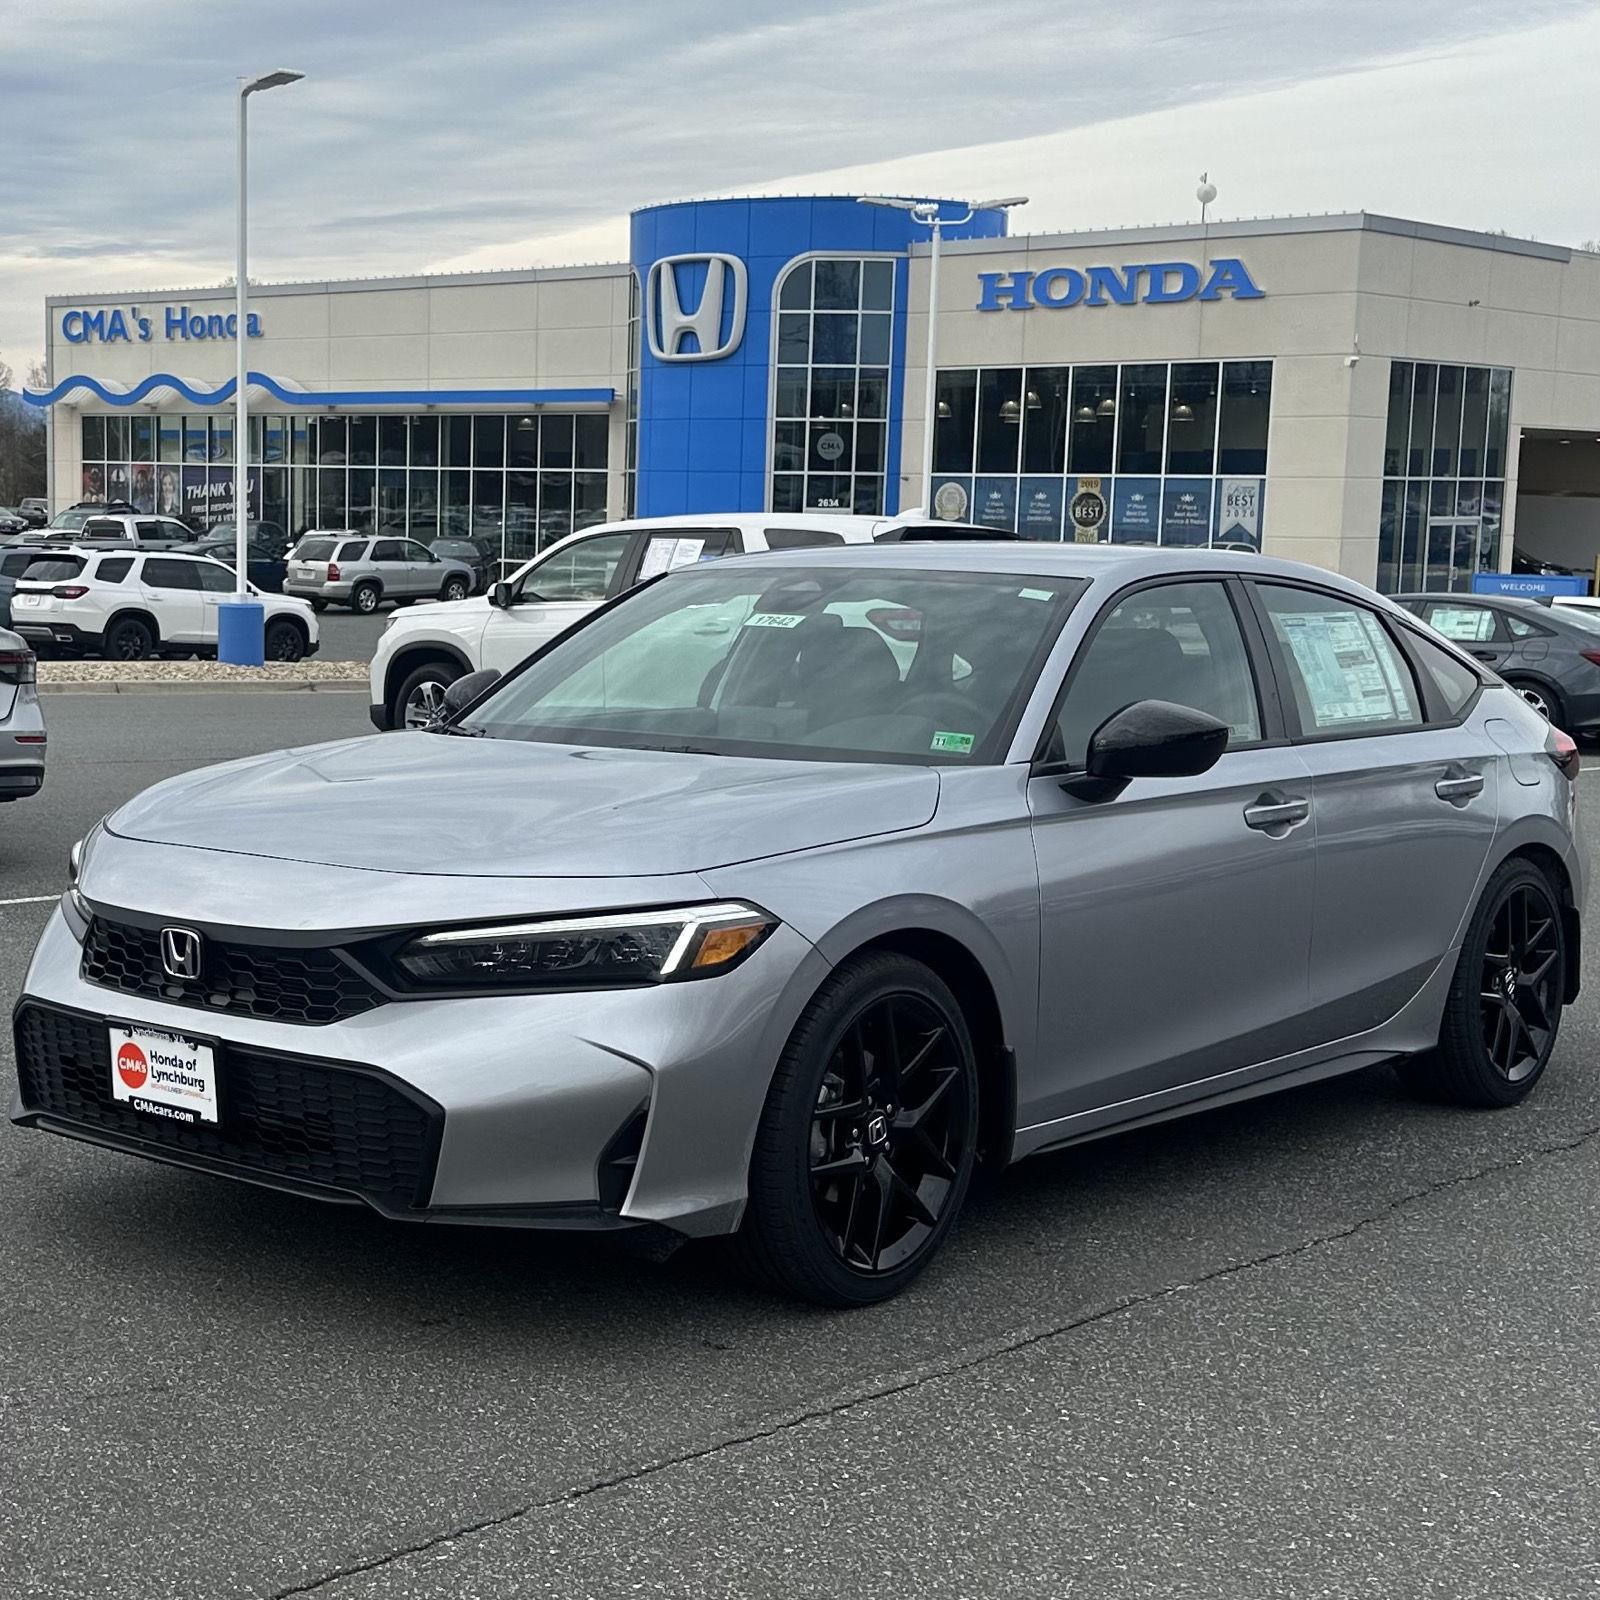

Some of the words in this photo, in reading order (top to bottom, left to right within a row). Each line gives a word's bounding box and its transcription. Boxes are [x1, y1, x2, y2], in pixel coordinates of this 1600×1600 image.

[976, 258, 1265, 311] HONDA
[62, 307, 152, 342] CMA's
[820, 442, 840, 450] CMA
[186, 482, 226, 500] THANK
[228, 479, 254, 496] YU
[1080, 480, 1099, 488] 2019
[817, 499, 840, 507] 2634
[1227, 495, 1255, 507] BEST
[190, 504, 208, 514] FIRS
[1075, 507, 1100, 518] BEST
[1226, 509, 1255, 518] 2020
[1500, 583, 1545, 592] WELCOME
[119, 1057, 146, 1073] CMA's
[150, 1050, 183, 1069] Honda
[186, 1059, 196, 1071] of
[151, 1066, 205, 1092] Lynchburg
[133, 1099, 194, 1123] CMAcars.com
